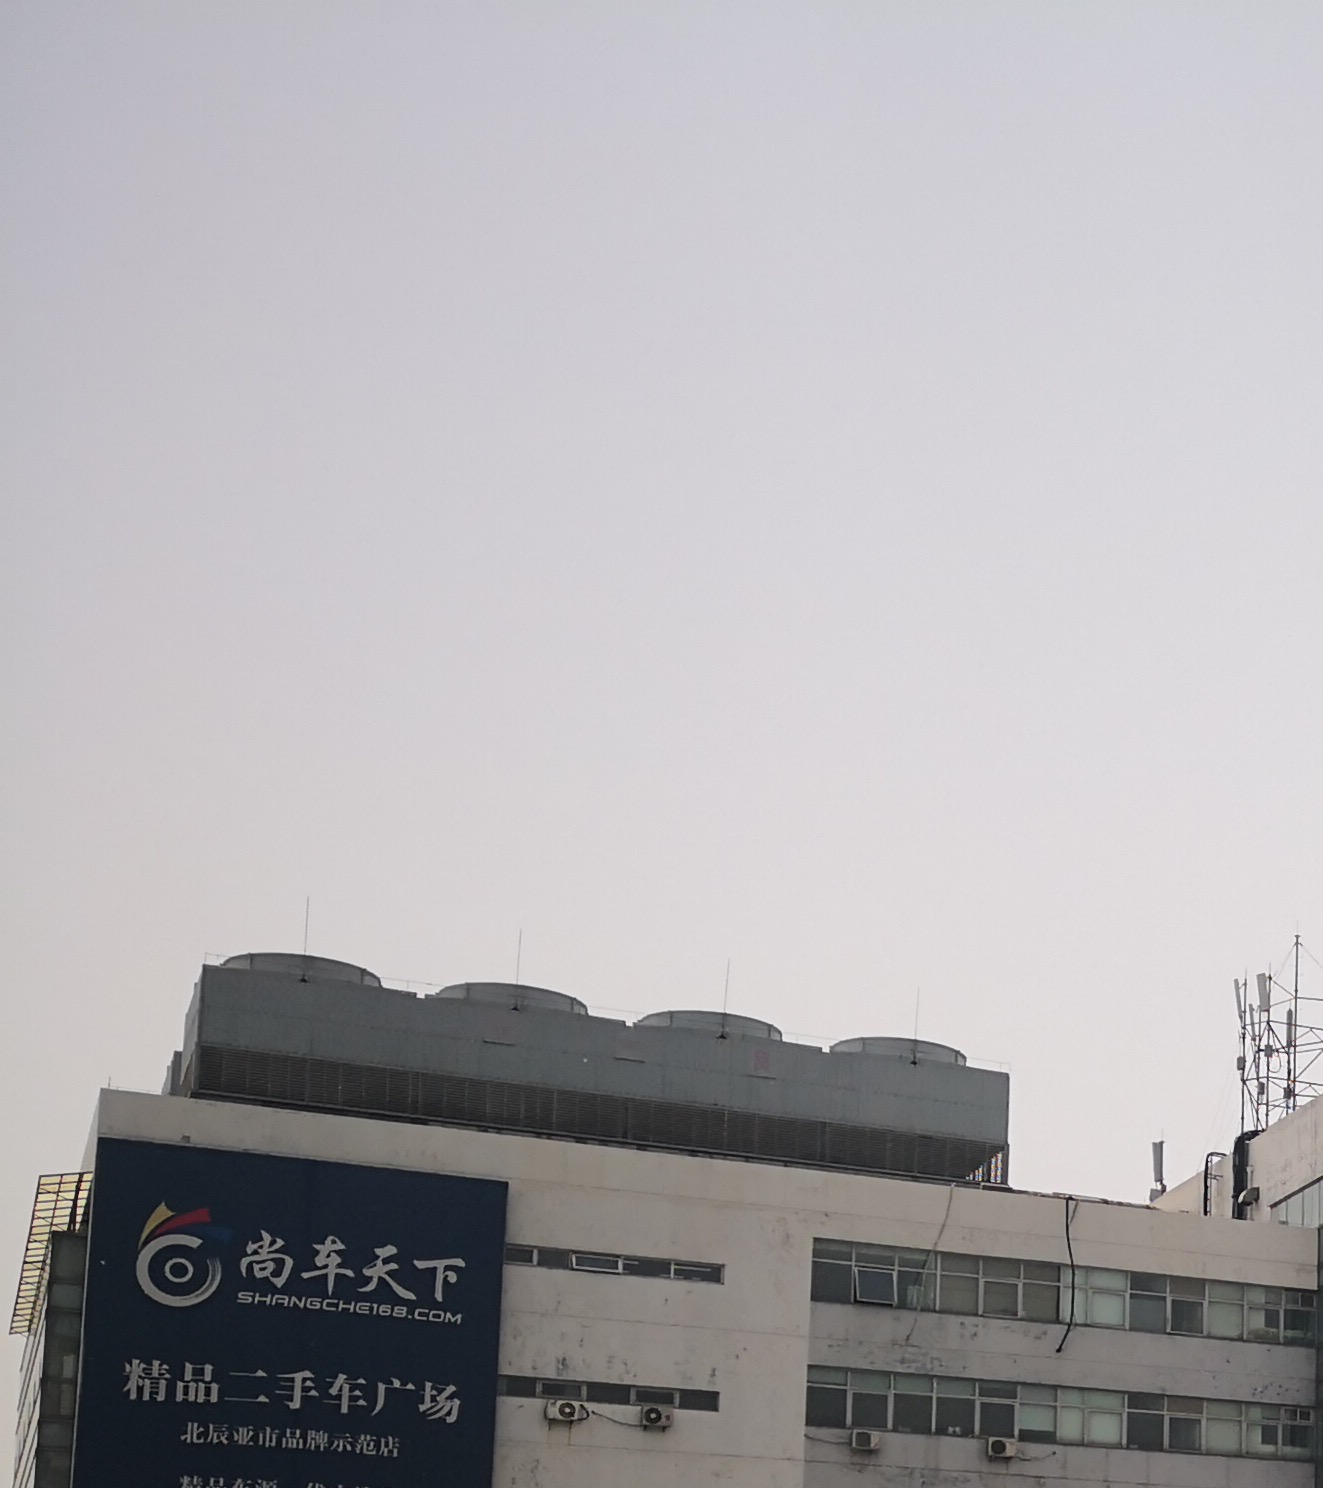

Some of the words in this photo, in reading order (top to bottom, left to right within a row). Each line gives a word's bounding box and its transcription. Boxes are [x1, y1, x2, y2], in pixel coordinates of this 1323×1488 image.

[238, 1229, 466, 1303] 尚车天下
[236, 1290, 463, 1326] SHANGCHE168.COM
[122, 1357, 462, 1425] 精品二手车广场
[180, 1421, 401, 1459] 北辰亚市品牌示范店
